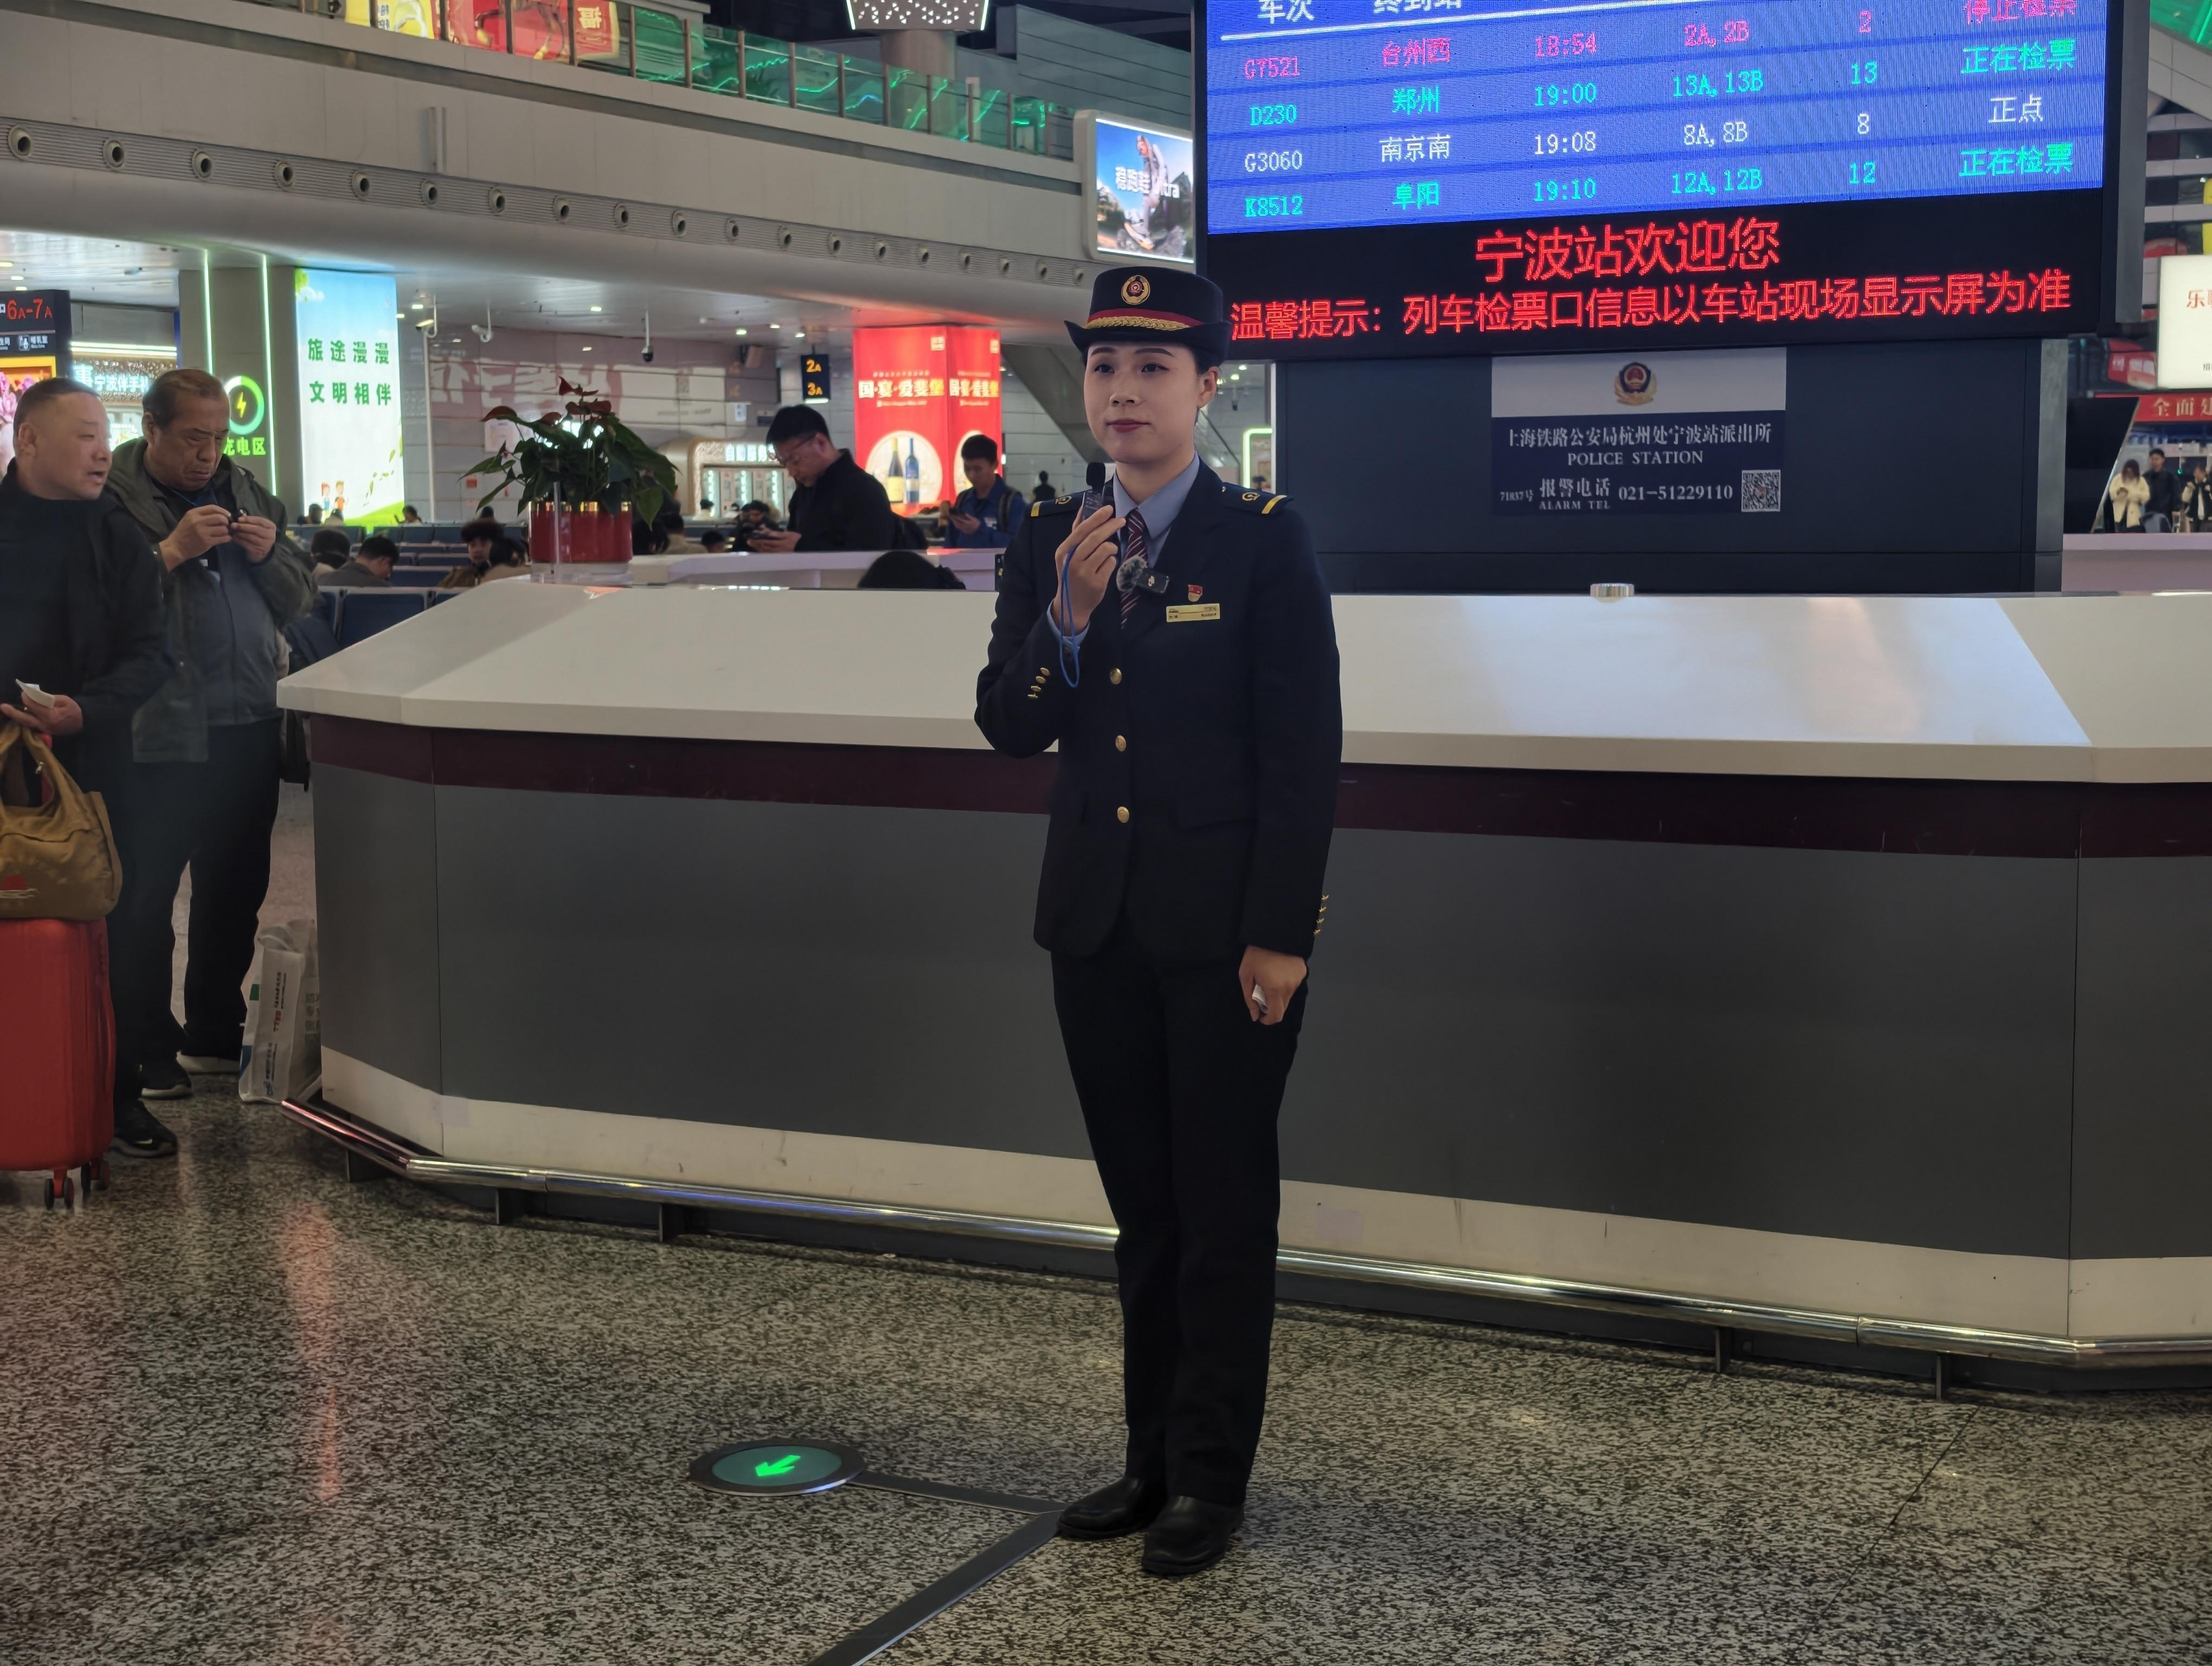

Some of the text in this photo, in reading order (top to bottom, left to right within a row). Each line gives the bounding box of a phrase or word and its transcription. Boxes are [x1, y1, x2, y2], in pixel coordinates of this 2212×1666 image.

[1258, 0, 1314, 23] 车次
[1859, 11, 1872, 33] 2
[1382, 37, 1451, 67] 台州西
[1535, 31, 1597, 57] 18:54
[1960, 37, 2076, 74] 正在检票
[1244, 56, 1300, 79] G7521
[1850, 61, 1878, 85] 13
[1392, 85, 1440, 115] 郑州
[1534, 81, 1597, 107] 19:00
[1250, 104, 1297, 126] D230
[1988, 93, 2044, 124] 正点
[1857, 113, 1870, 136] 8
[1379, 133, 1451, 163] 南京南
[1534, 131, 1597, 156] 19:08
[1245, 151, 1303, 173] G3060
[1959, 142, 2074, 177] 正在检票
[1849, 161, 1876, 185] 12
[1392, 182, 1440, 210] 阜阳
[1534, 178, 1597, 202] 19:10
[1245, 195, 1303, 218] K8512
[1475, 217, 1780, 283] 宁波站欢迎您
[2187, 289, 2212, 309] 乐
[308, 338, 389, 364] 旅途漫漫
[806, 359, 822, 373] 2A
[310, 381, 391, 406] 文明相伴
[807, 382, 823, 396] 3A
[1568, 450, 1703, 465] POLICE STATION
[1539, 477, 1610, 498] 报警电话
[1618, 485, 1733, 501] 021-51229110
[1539, 500, 1611, 510] ALARM TEL
